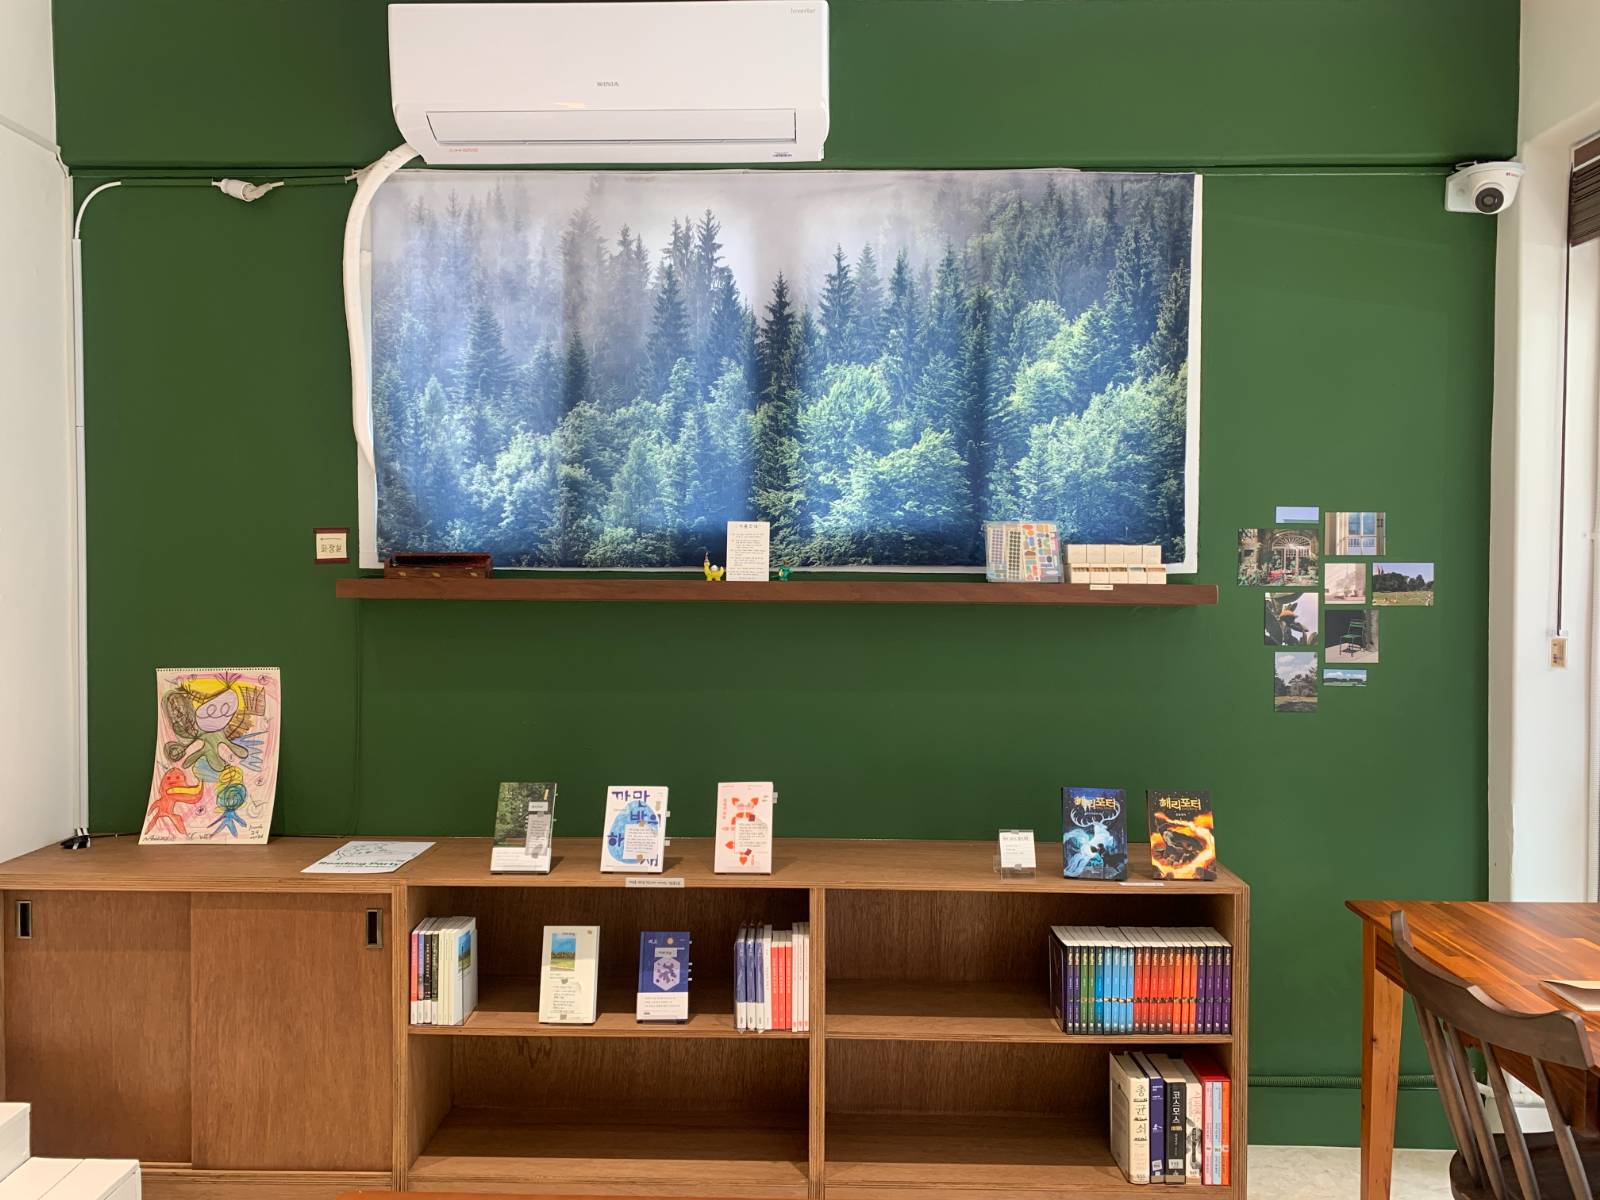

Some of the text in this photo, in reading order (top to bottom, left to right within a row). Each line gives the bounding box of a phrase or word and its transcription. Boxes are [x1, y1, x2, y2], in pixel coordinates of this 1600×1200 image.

[611, 790, 650, 808] 까만
[1074, 795, 1118, 810] 해리포터
[1159, 797, 1202, 811] 해리포터
[1172, 1091, 1181, 1124] 코스모스
